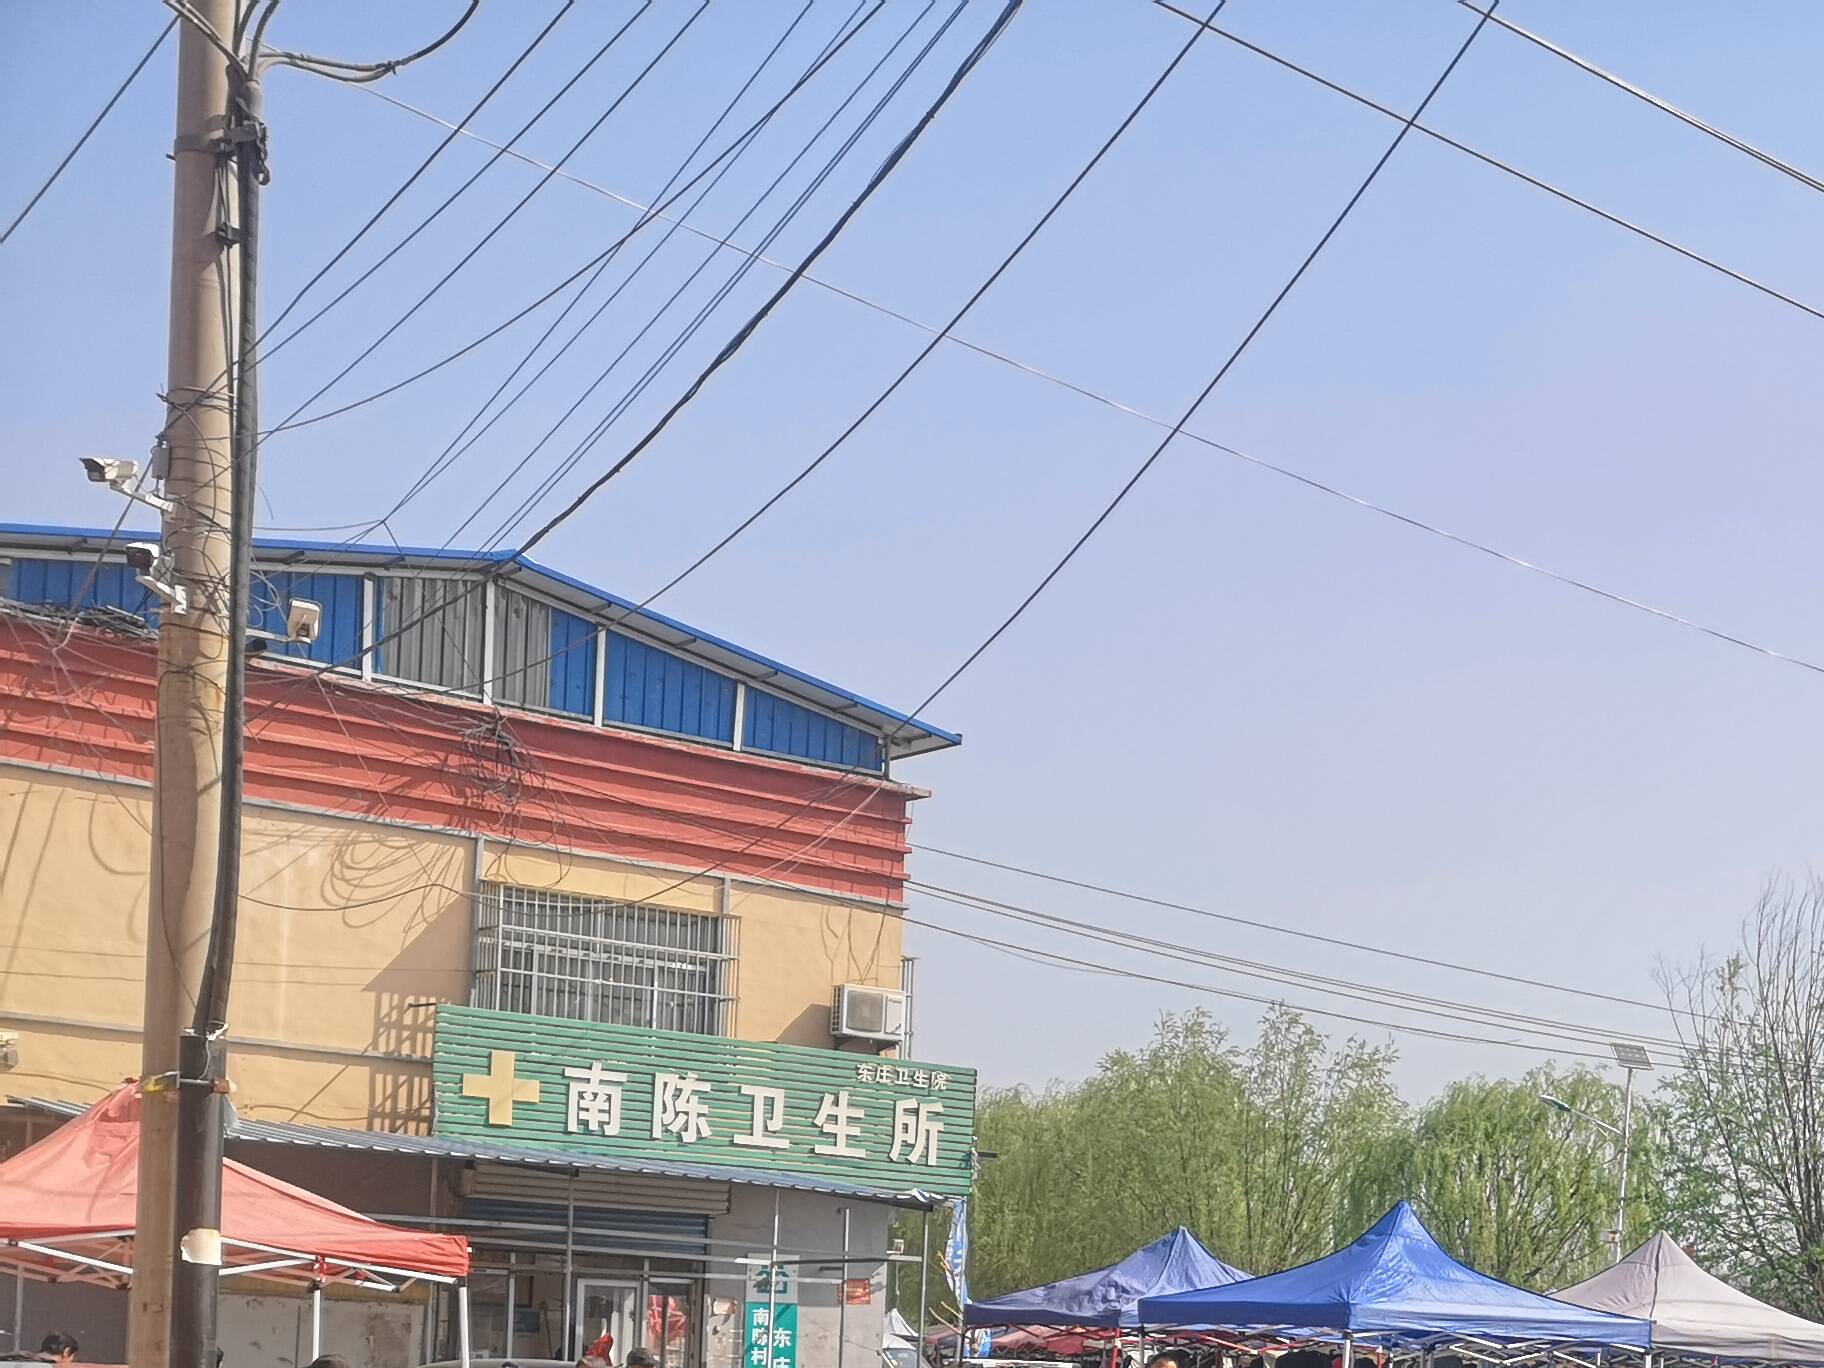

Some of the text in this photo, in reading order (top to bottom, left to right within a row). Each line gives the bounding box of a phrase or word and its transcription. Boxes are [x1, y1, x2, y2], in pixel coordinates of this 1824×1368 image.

[857, 1063, 950, 1091] 东庄卫生院
[564, 1062, 944, 1166] 南陈卫生所
